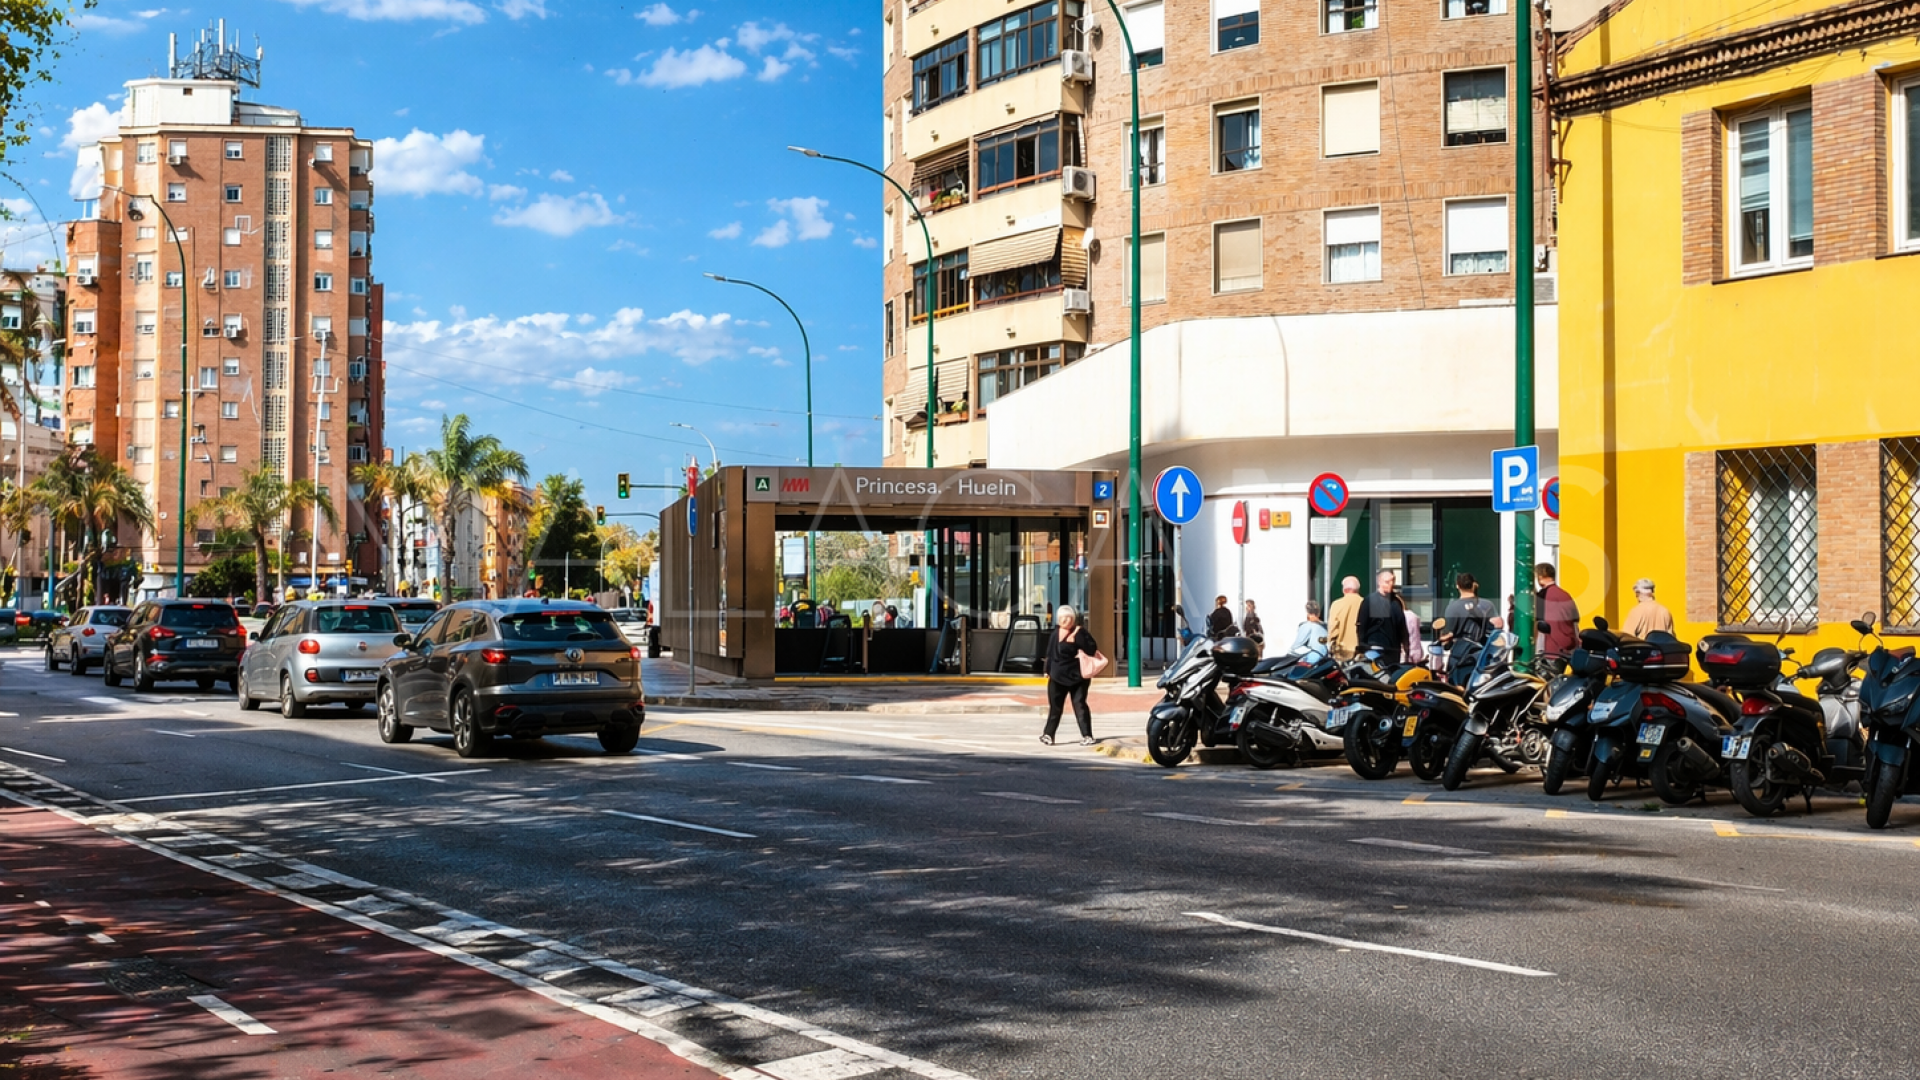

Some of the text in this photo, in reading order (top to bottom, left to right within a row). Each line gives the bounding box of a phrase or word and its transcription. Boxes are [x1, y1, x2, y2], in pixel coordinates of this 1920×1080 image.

[757, 478, 768, 490] A
[1501, 455, 1529, 504] P
[1099, 484, 1108, 497] 2
